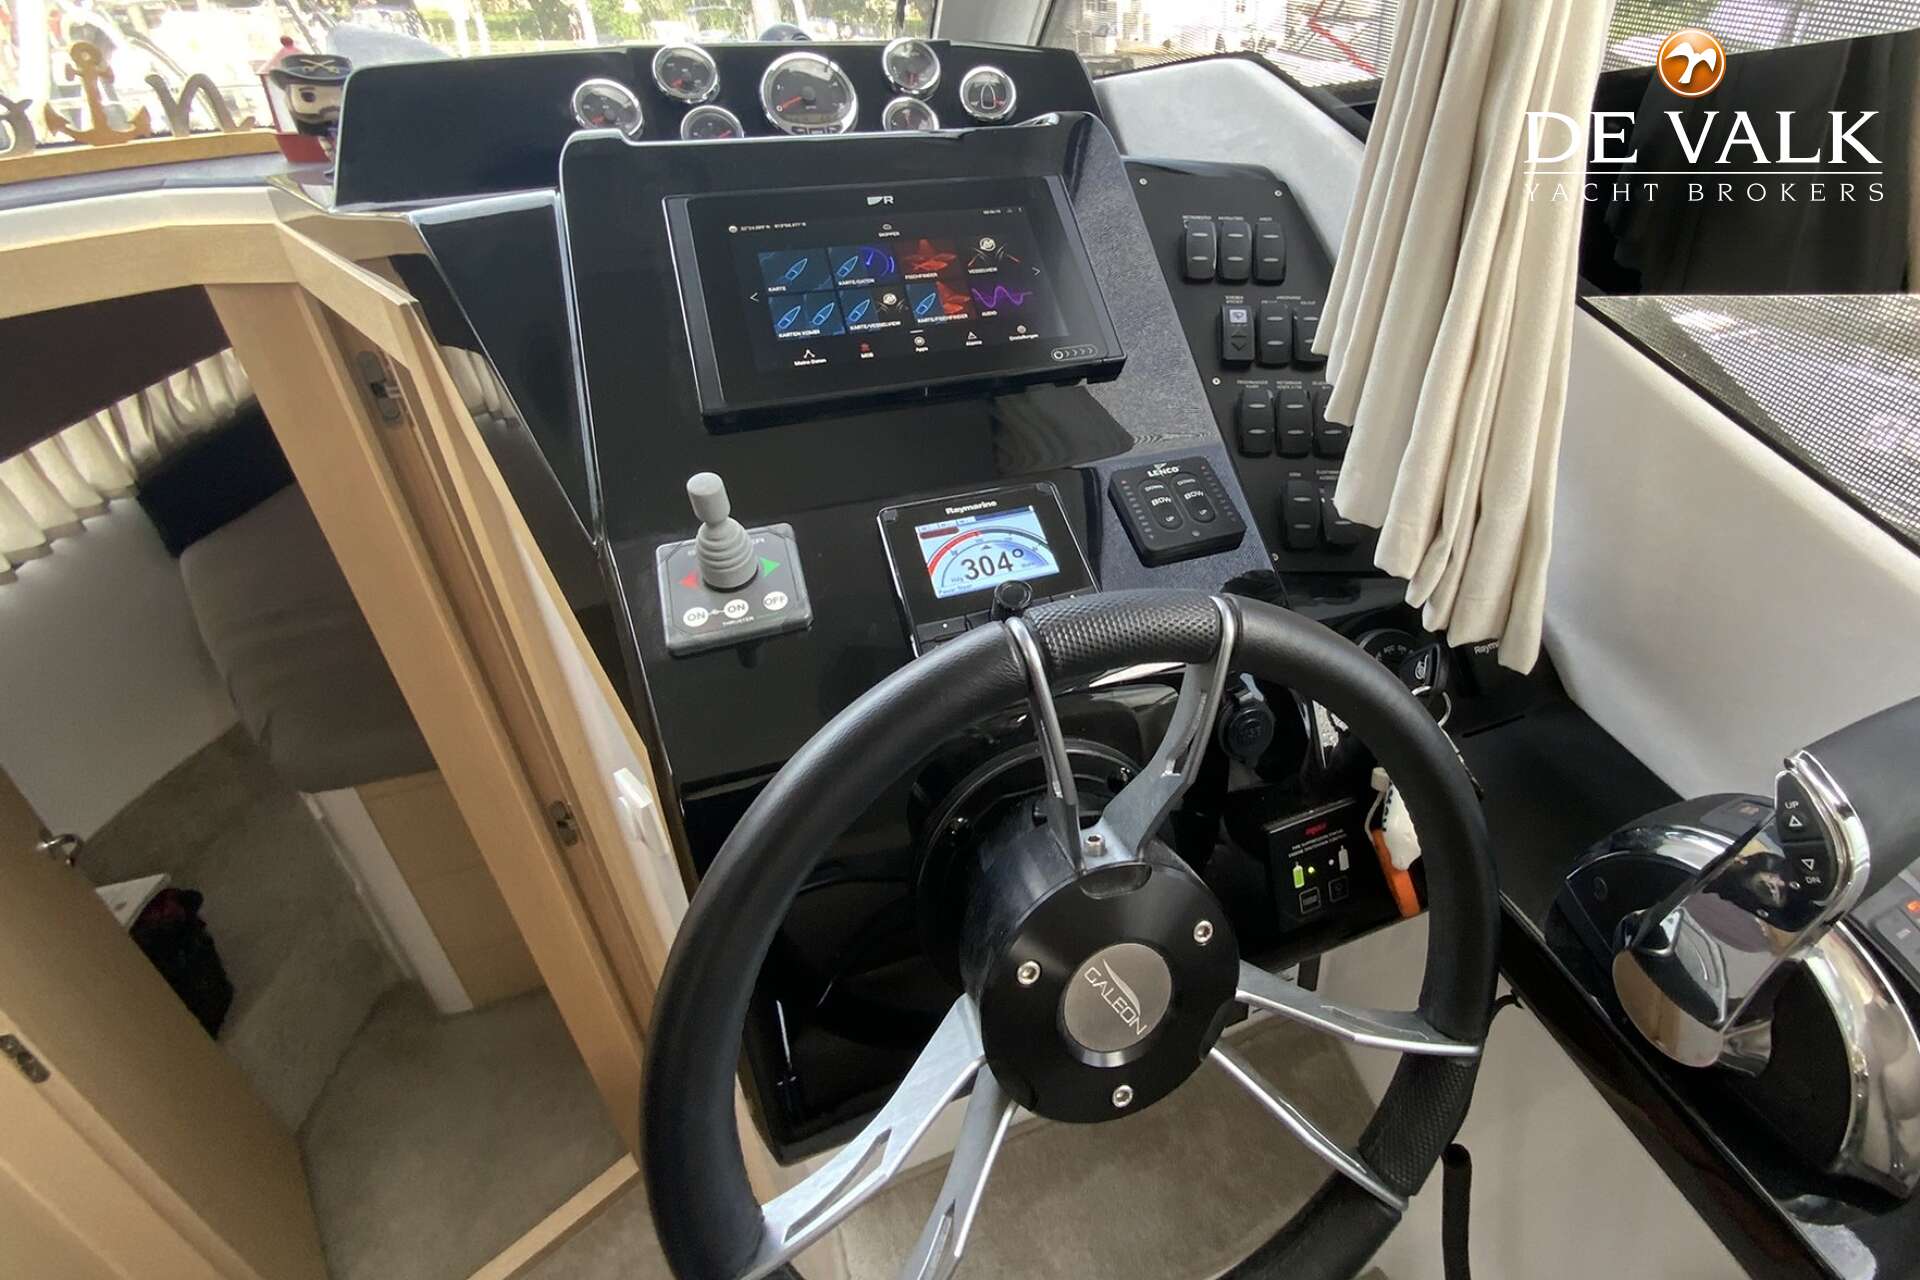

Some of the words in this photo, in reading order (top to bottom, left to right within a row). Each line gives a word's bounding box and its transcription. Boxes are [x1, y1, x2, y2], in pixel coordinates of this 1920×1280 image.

[1147, 466, 1180, 477] LENCO
[945, 500, 998, 515] Raymarine
[764, 596, 787, 606] OFF
[687, 611, 706, 622] ON
[727, 603, 746, 614] ON
[1785, 801, 1800, 810] UP
[1084, 966, 1148, 1036] GALEON
